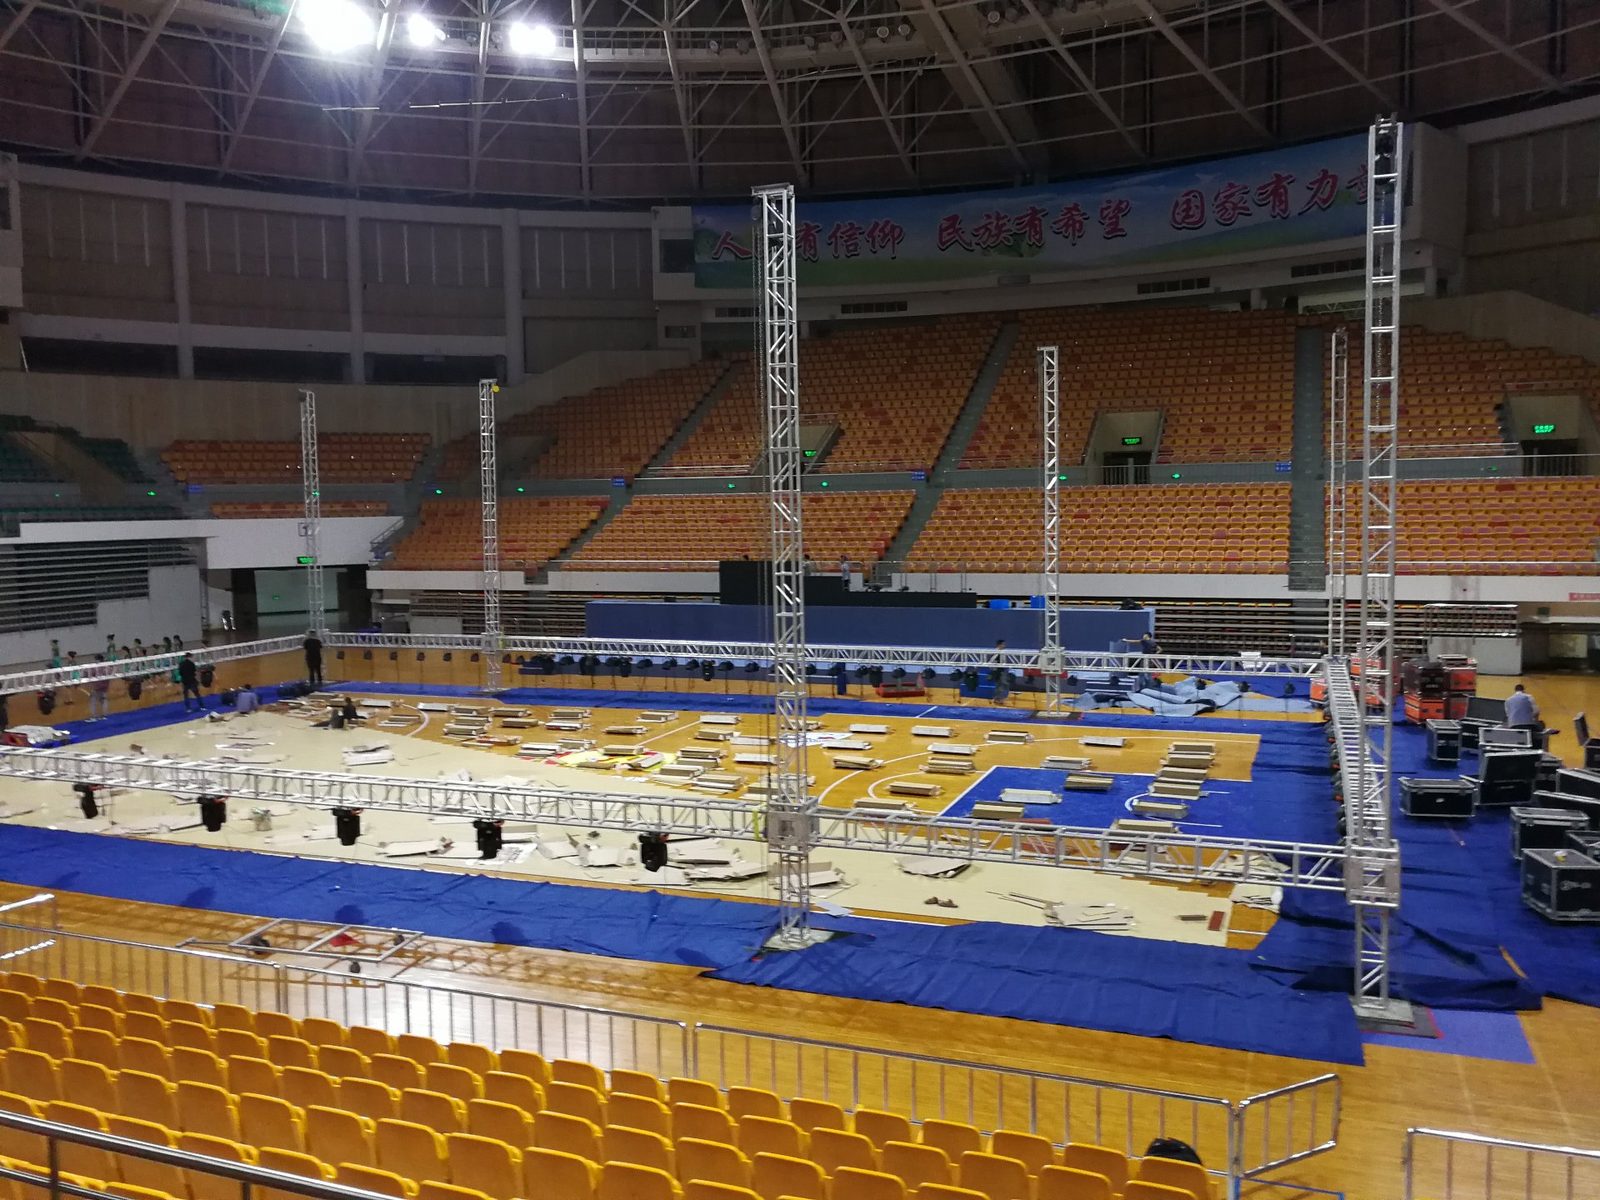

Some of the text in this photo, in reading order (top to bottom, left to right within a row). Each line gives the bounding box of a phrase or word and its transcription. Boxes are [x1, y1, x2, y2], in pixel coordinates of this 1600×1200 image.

[712, 221, 903, 261] 人有信仰
[937, 199, 1131, 251] 民族有希望
